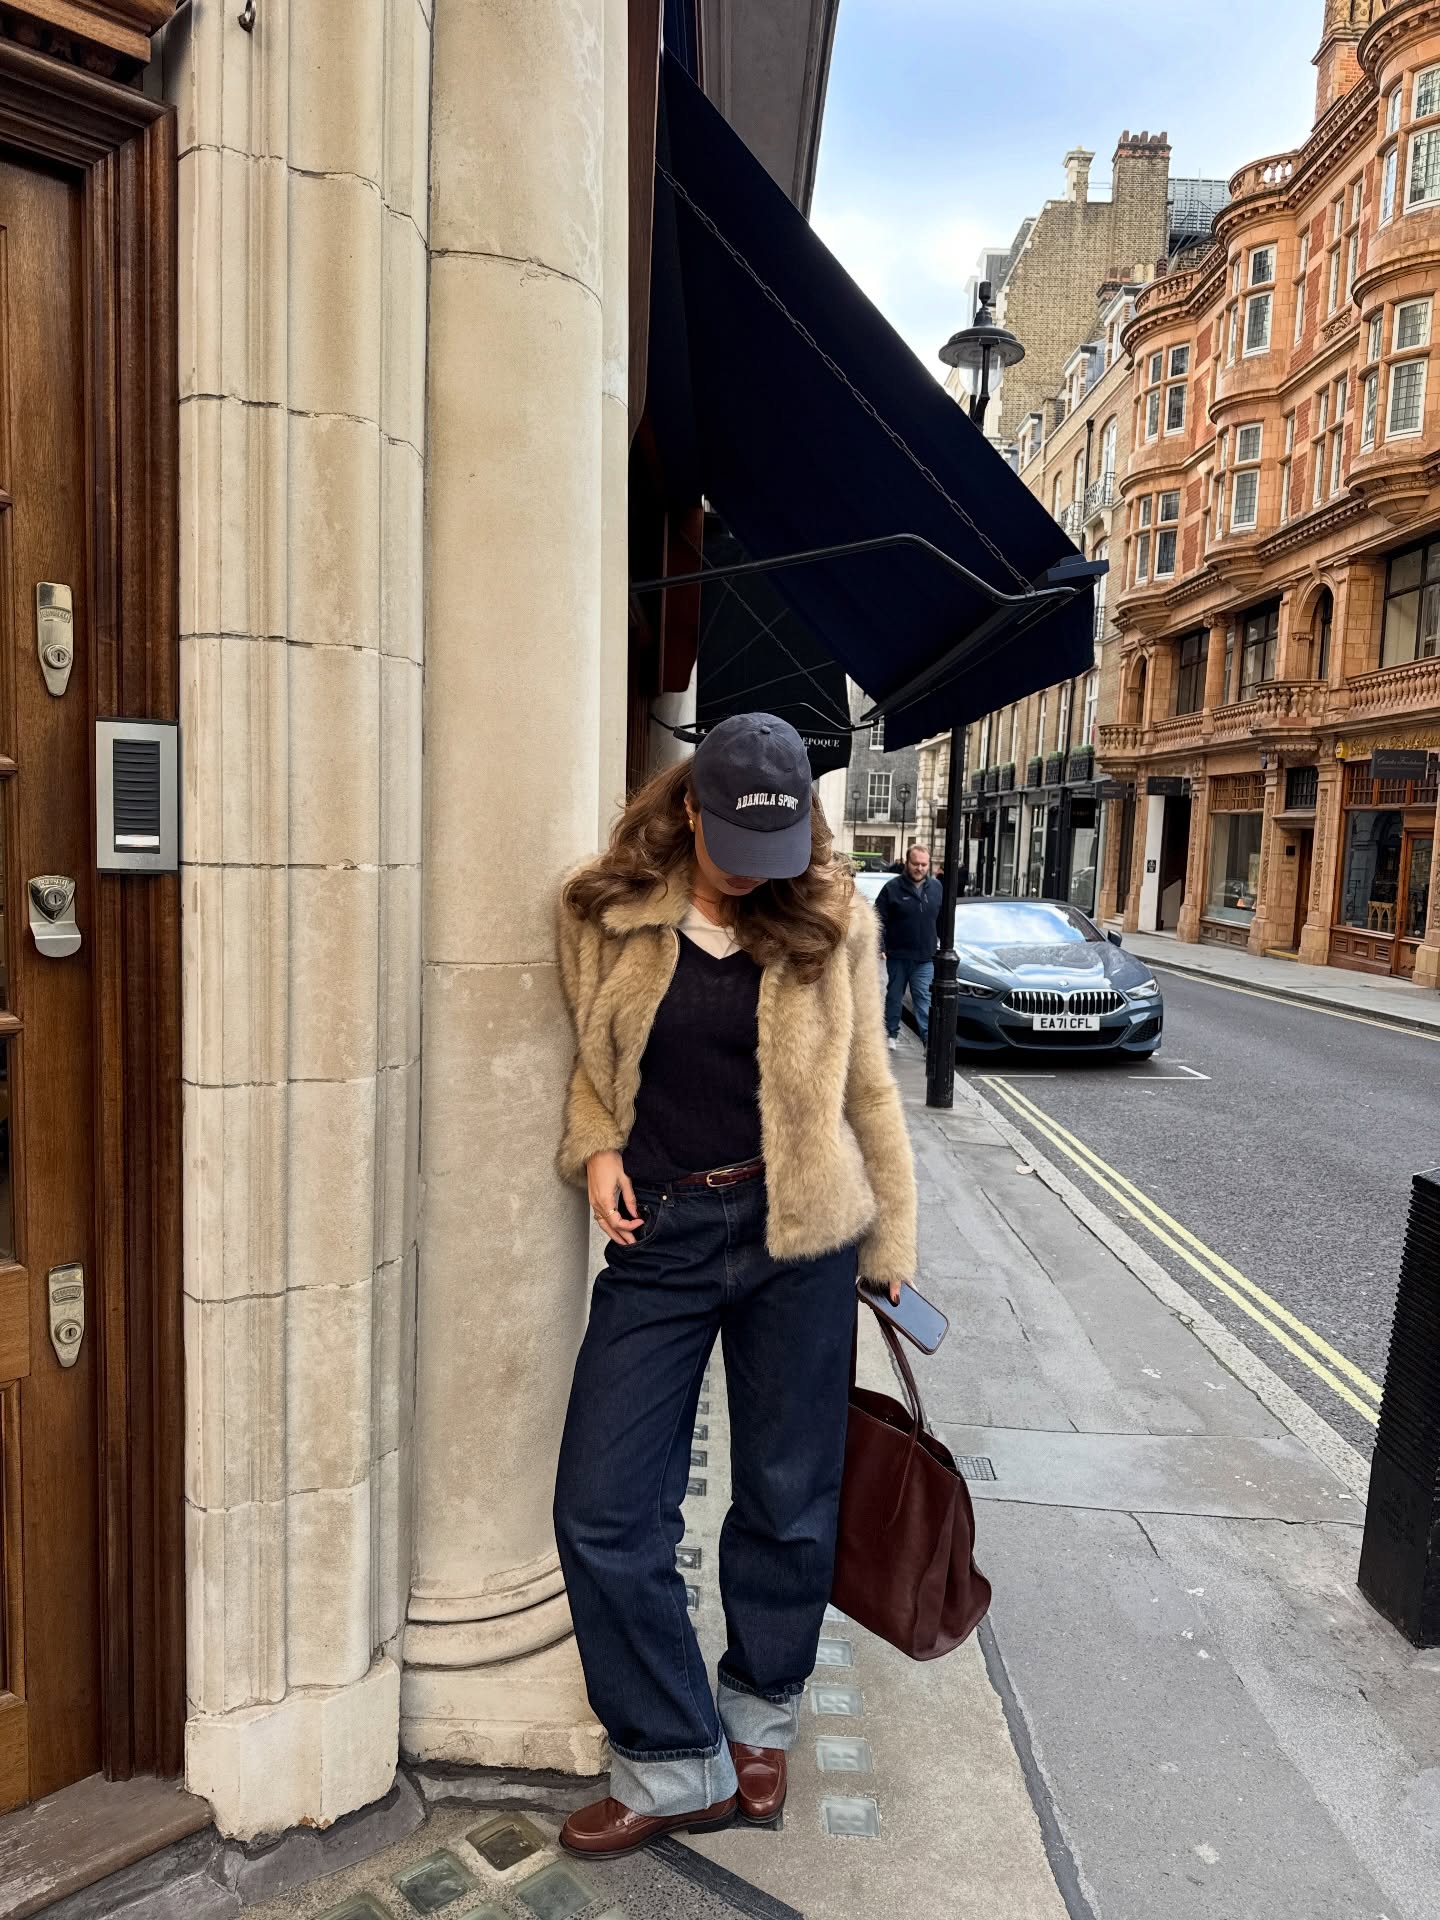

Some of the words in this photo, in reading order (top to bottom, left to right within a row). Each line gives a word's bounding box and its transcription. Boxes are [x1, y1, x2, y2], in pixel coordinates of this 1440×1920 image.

[735, 792, 776, 810] ADANOLA
[777, 793, 799, 811] SPORT
[1040, 1017, 1067, 1029] EA71
[1070, 1017, 1093, 1029] CFL
